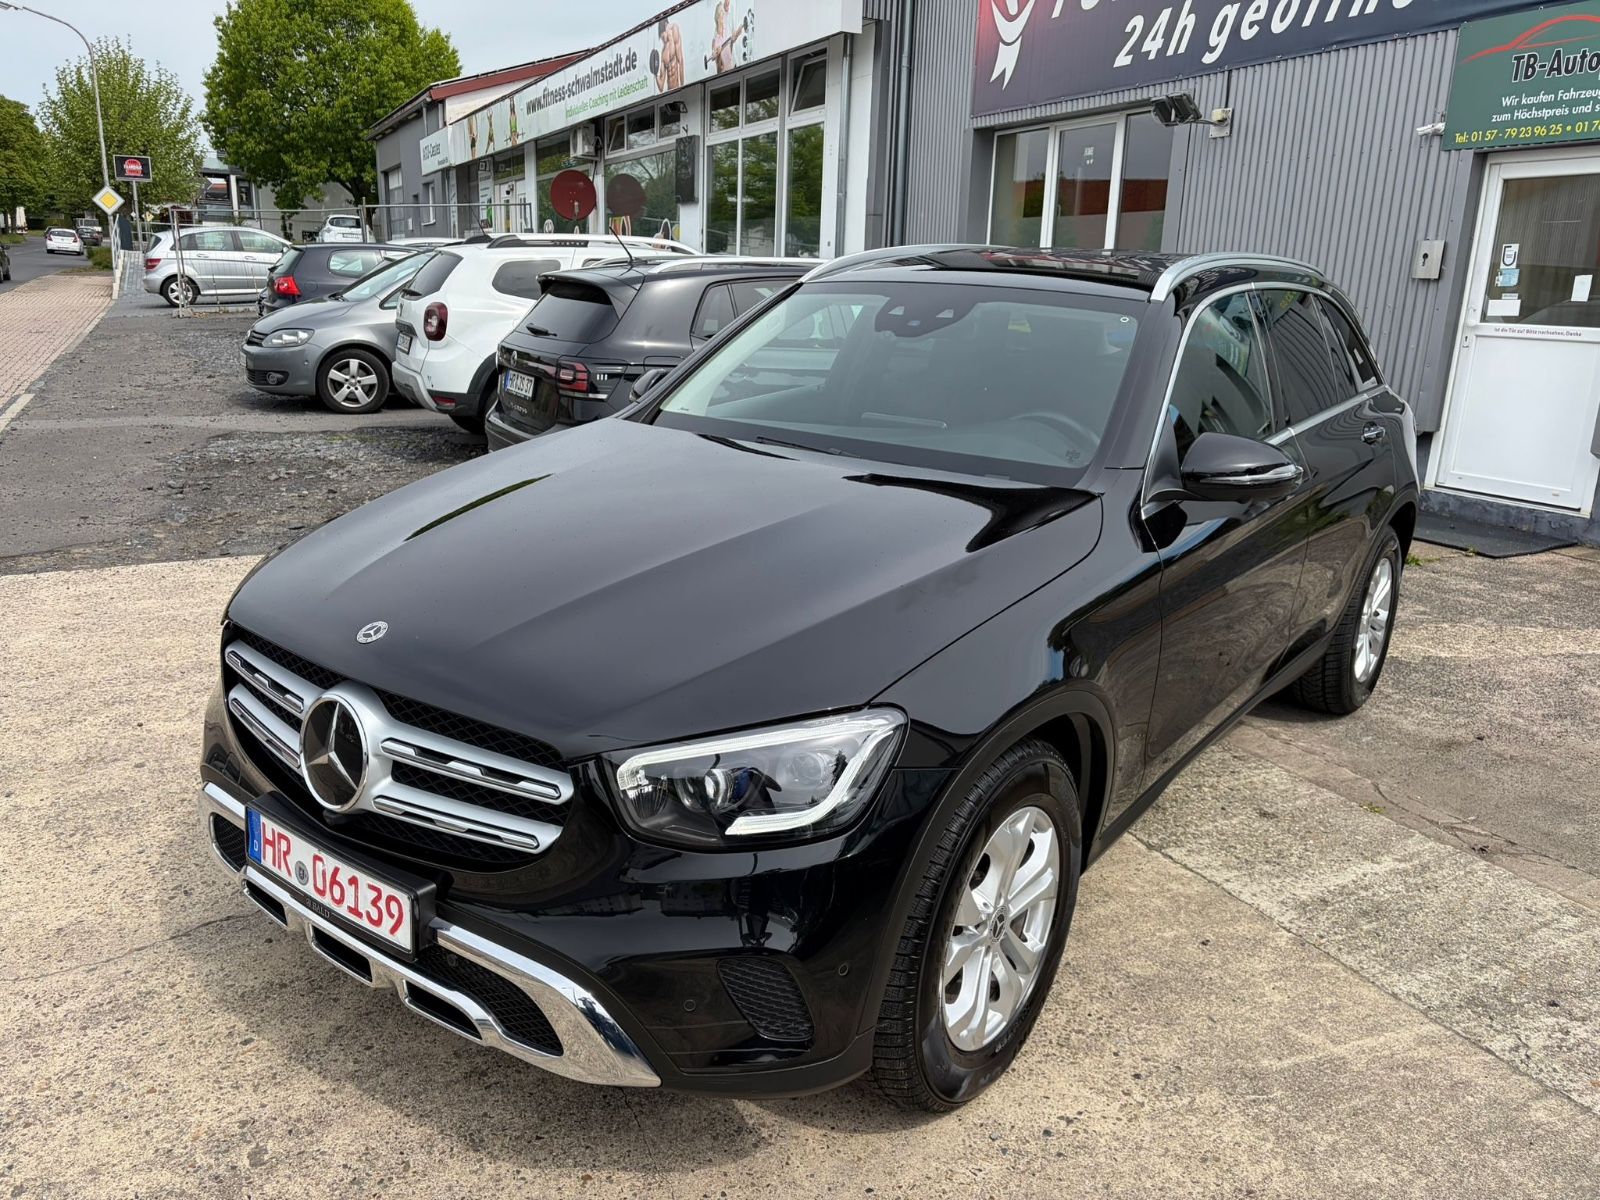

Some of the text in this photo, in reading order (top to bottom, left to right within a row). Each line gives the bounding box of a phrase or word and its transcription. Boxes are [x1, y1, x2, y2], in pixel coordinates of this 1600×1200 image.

[1113, 1, 1197, 68] 24h
[526, 48, 637, 115] www.fitness-schwalmstadt.de
[1502, 95, 1519, 107] Wir
[1521, 91, 1554, 105] kaufen
[1491, 113, 1511, 122] zum
[1513, 104, 1569, 120] Höchstpreis
[1572, 100, 1593, 114] und
[1455, 132, 1469, 143] Tel:
[262, 822, 404, 936] HR 06139
